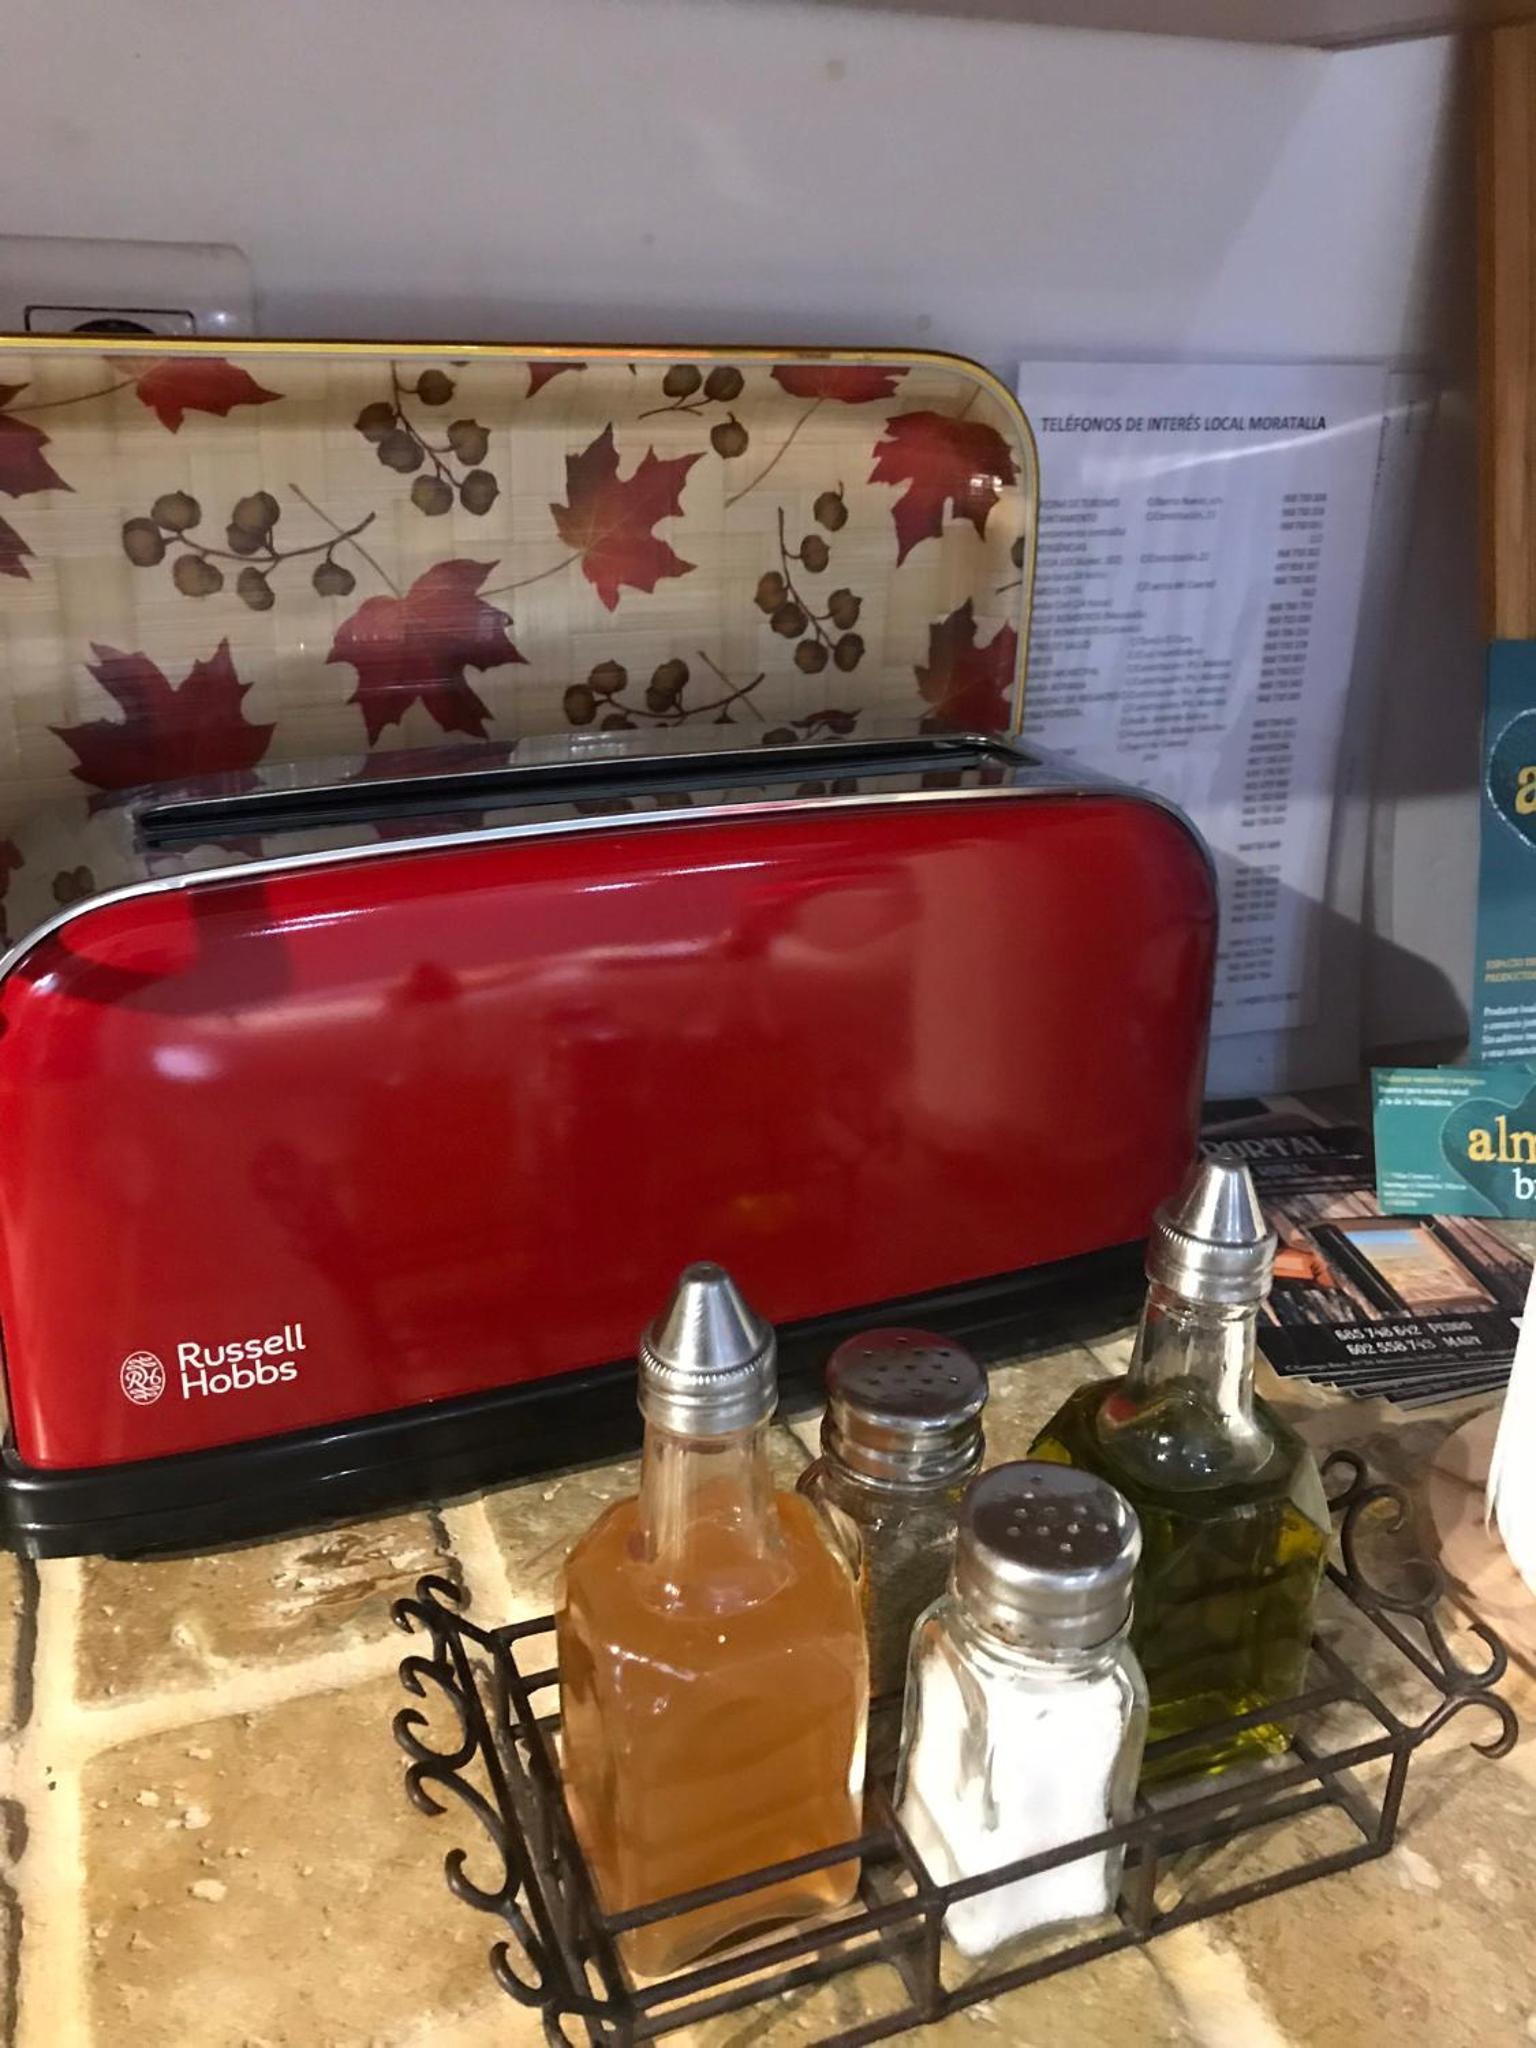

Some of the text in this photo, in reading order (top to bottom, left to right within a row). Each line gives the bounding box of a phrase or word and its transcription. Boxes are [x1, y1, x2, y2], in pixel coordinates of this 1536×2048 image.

[1041, 414, 1326, 432] TELÉFONOS DE INTERÉS LOCAL MORATALLA
[1512, 1168, 1536, 1200] b
[177, 1323, 306, 1372] Russell
[181, 1359, 298, 1400] Hobbs
